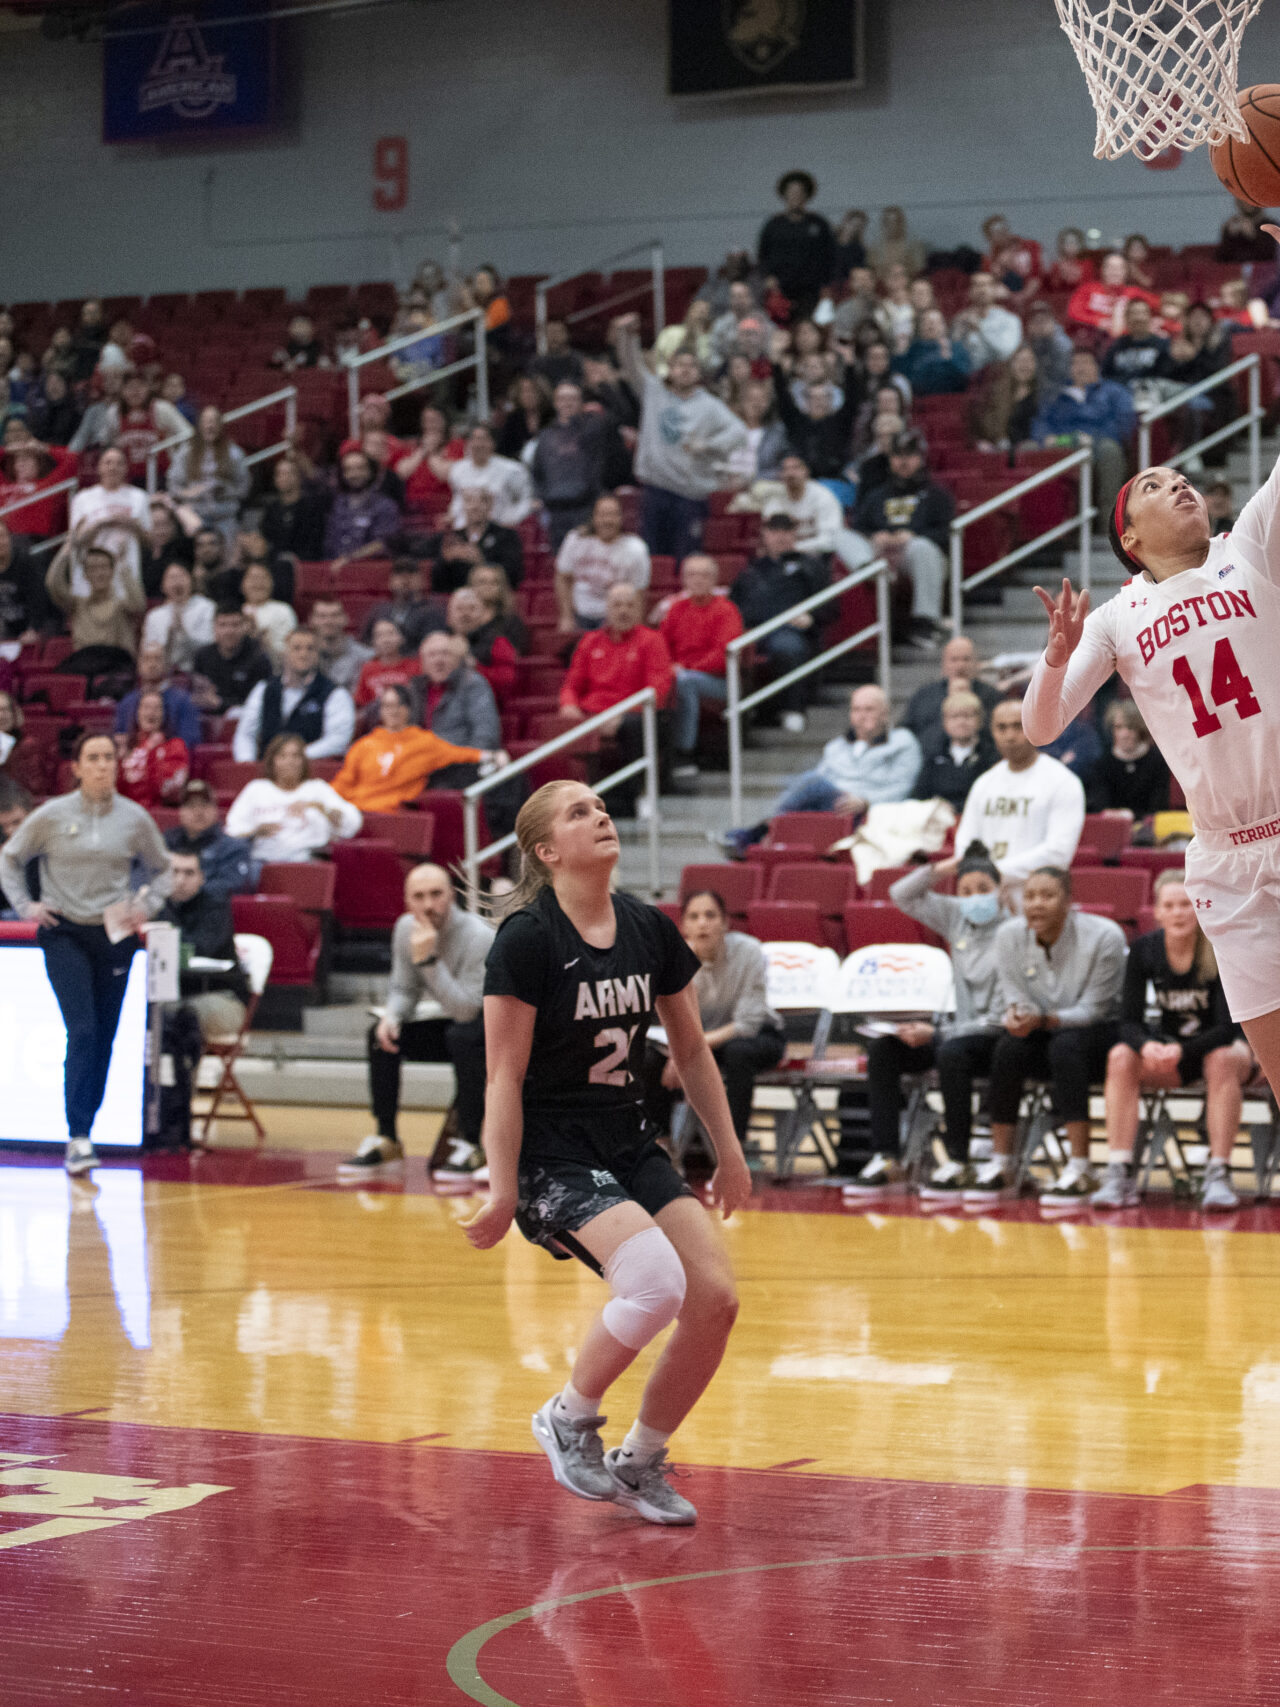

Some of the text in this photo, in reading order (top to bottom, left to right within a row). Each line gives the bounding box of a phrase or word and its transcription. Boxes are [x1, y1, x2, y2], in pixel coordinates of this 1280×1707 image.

[375, 136, 408, 210] 9
[1136, 590, 1258, 666] BOSTON
[1172, 637, 1262, 738] 14
[574, 973, 651, 1020] ARMY
[588, 1024, 640, 1087] 2
